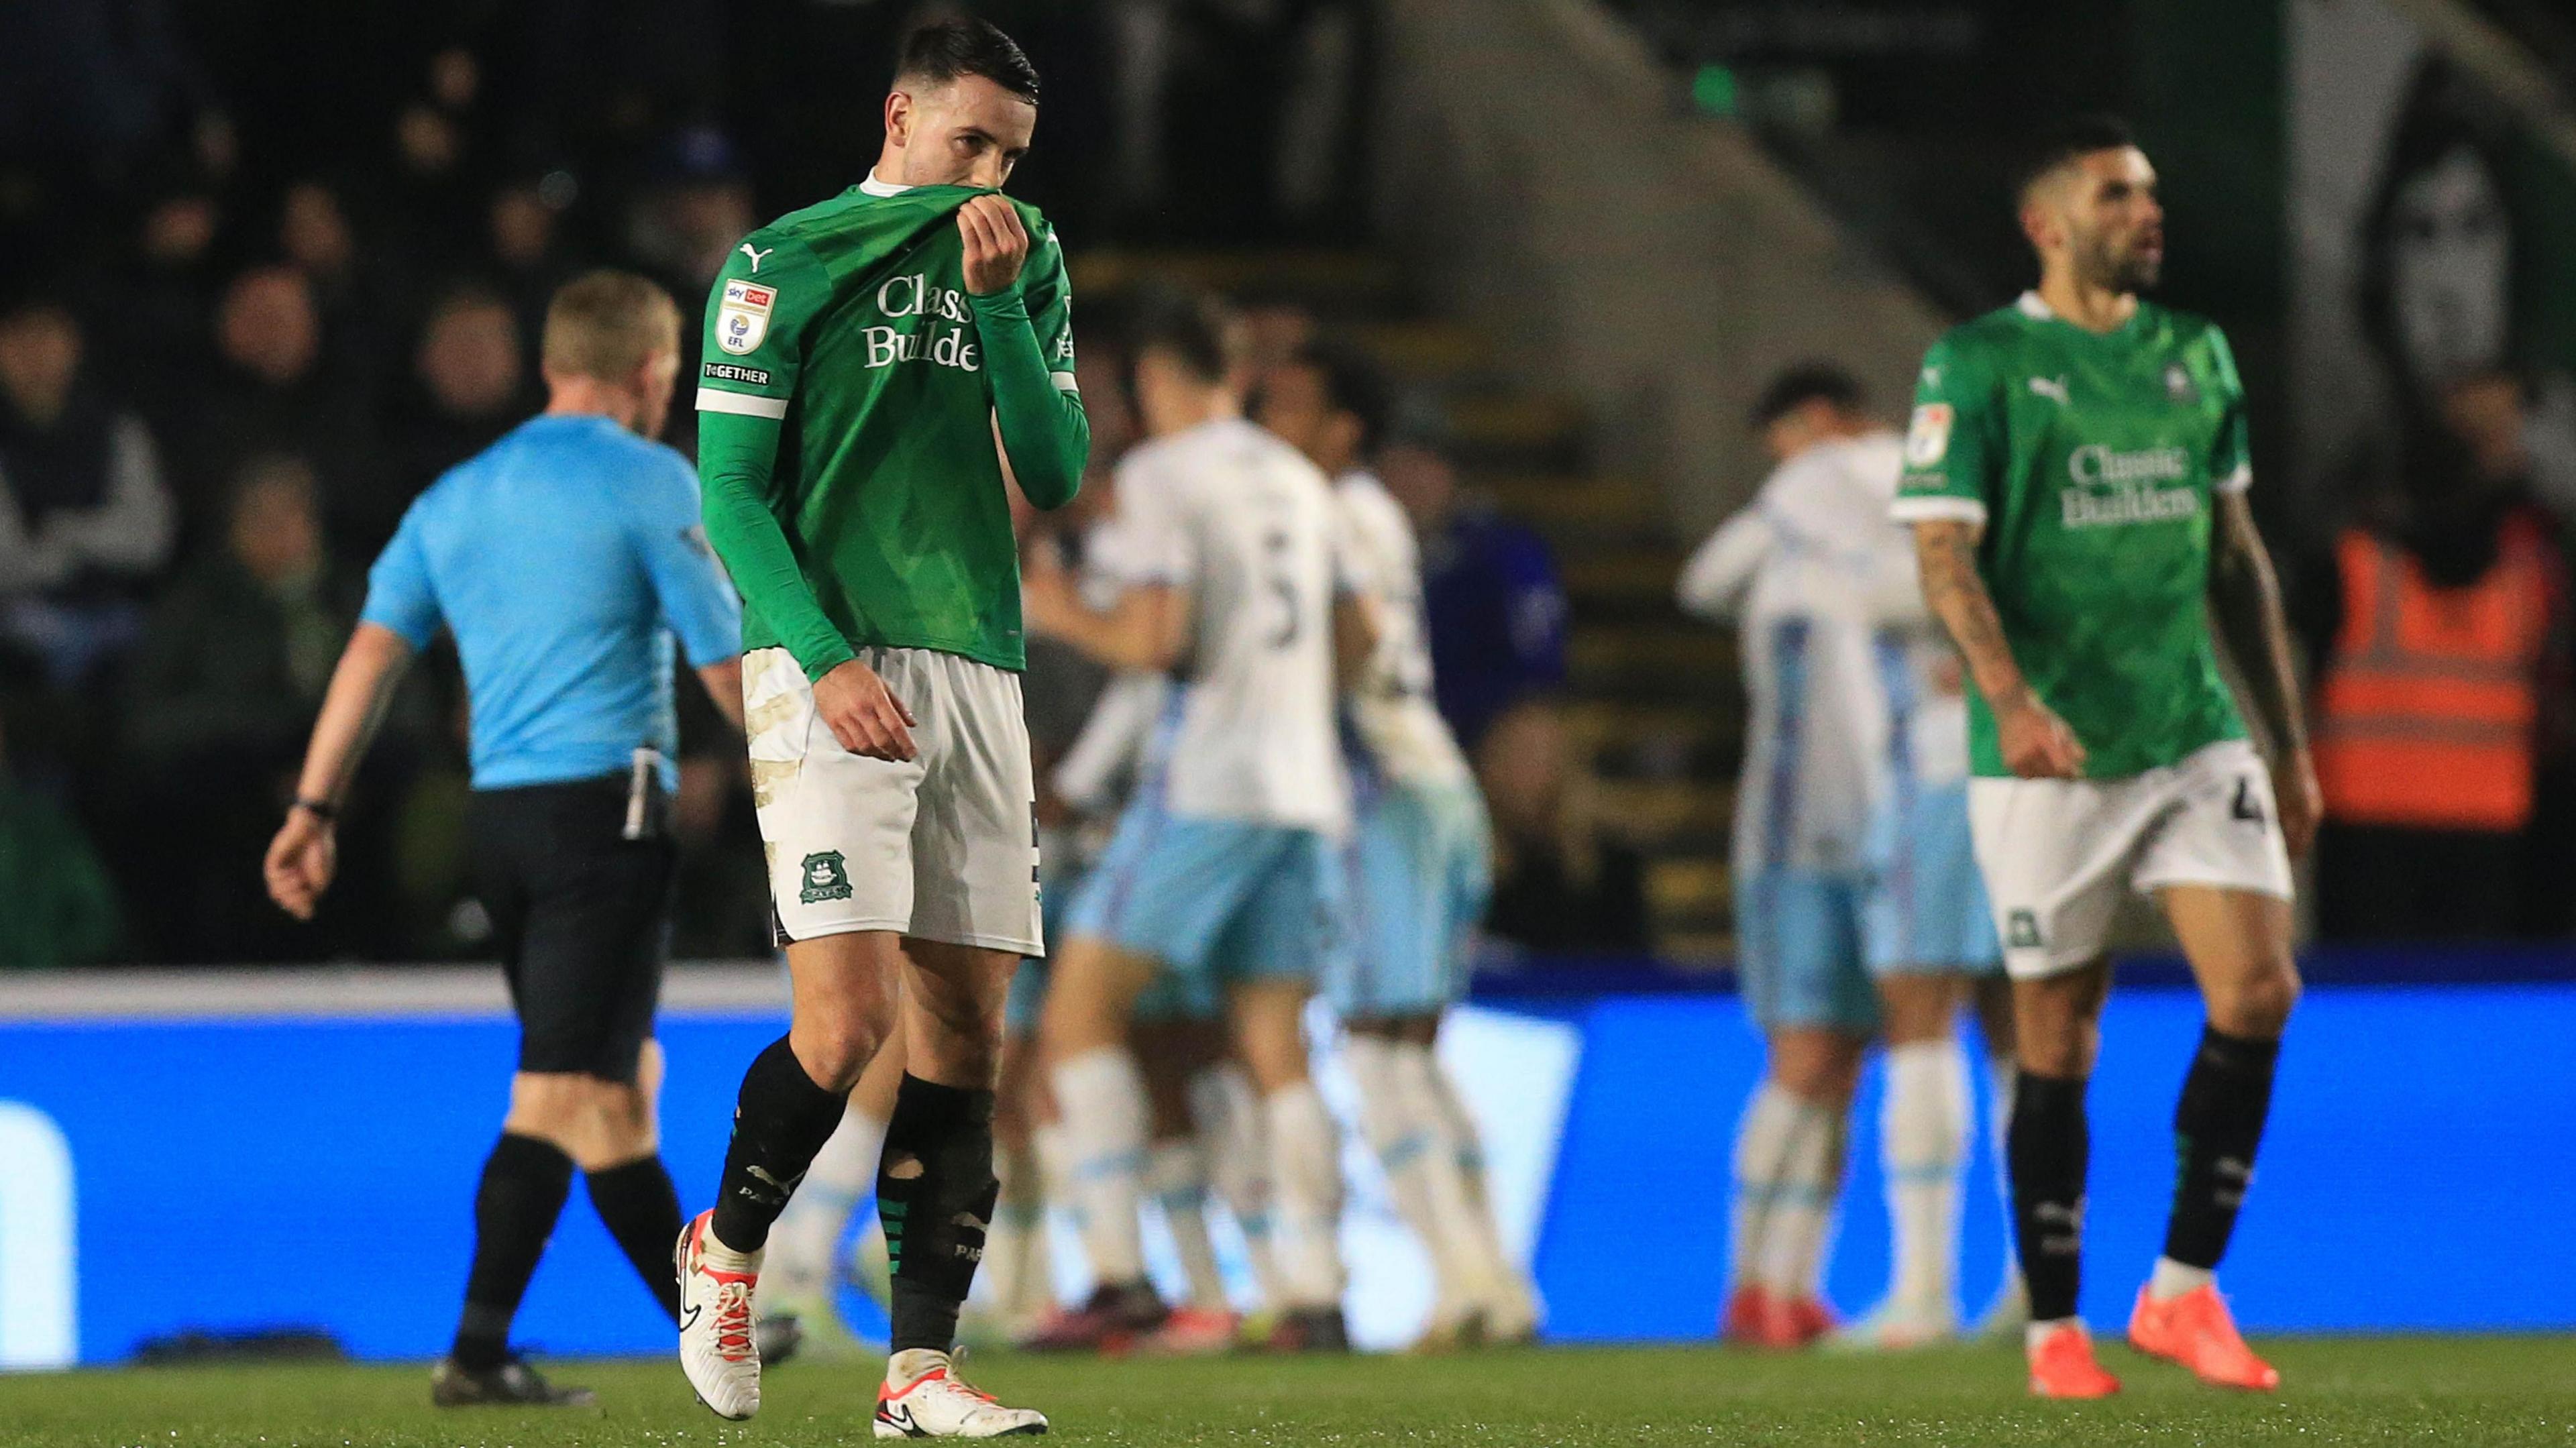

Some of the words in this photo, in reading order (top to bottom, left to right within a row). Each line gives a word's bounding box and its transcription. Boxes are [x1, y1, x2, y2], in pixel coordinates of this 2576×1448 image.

[728, 287, 745, 300] sky
[747, 290, 767, 304] bet
[728, 337, 744, 347] EFL
